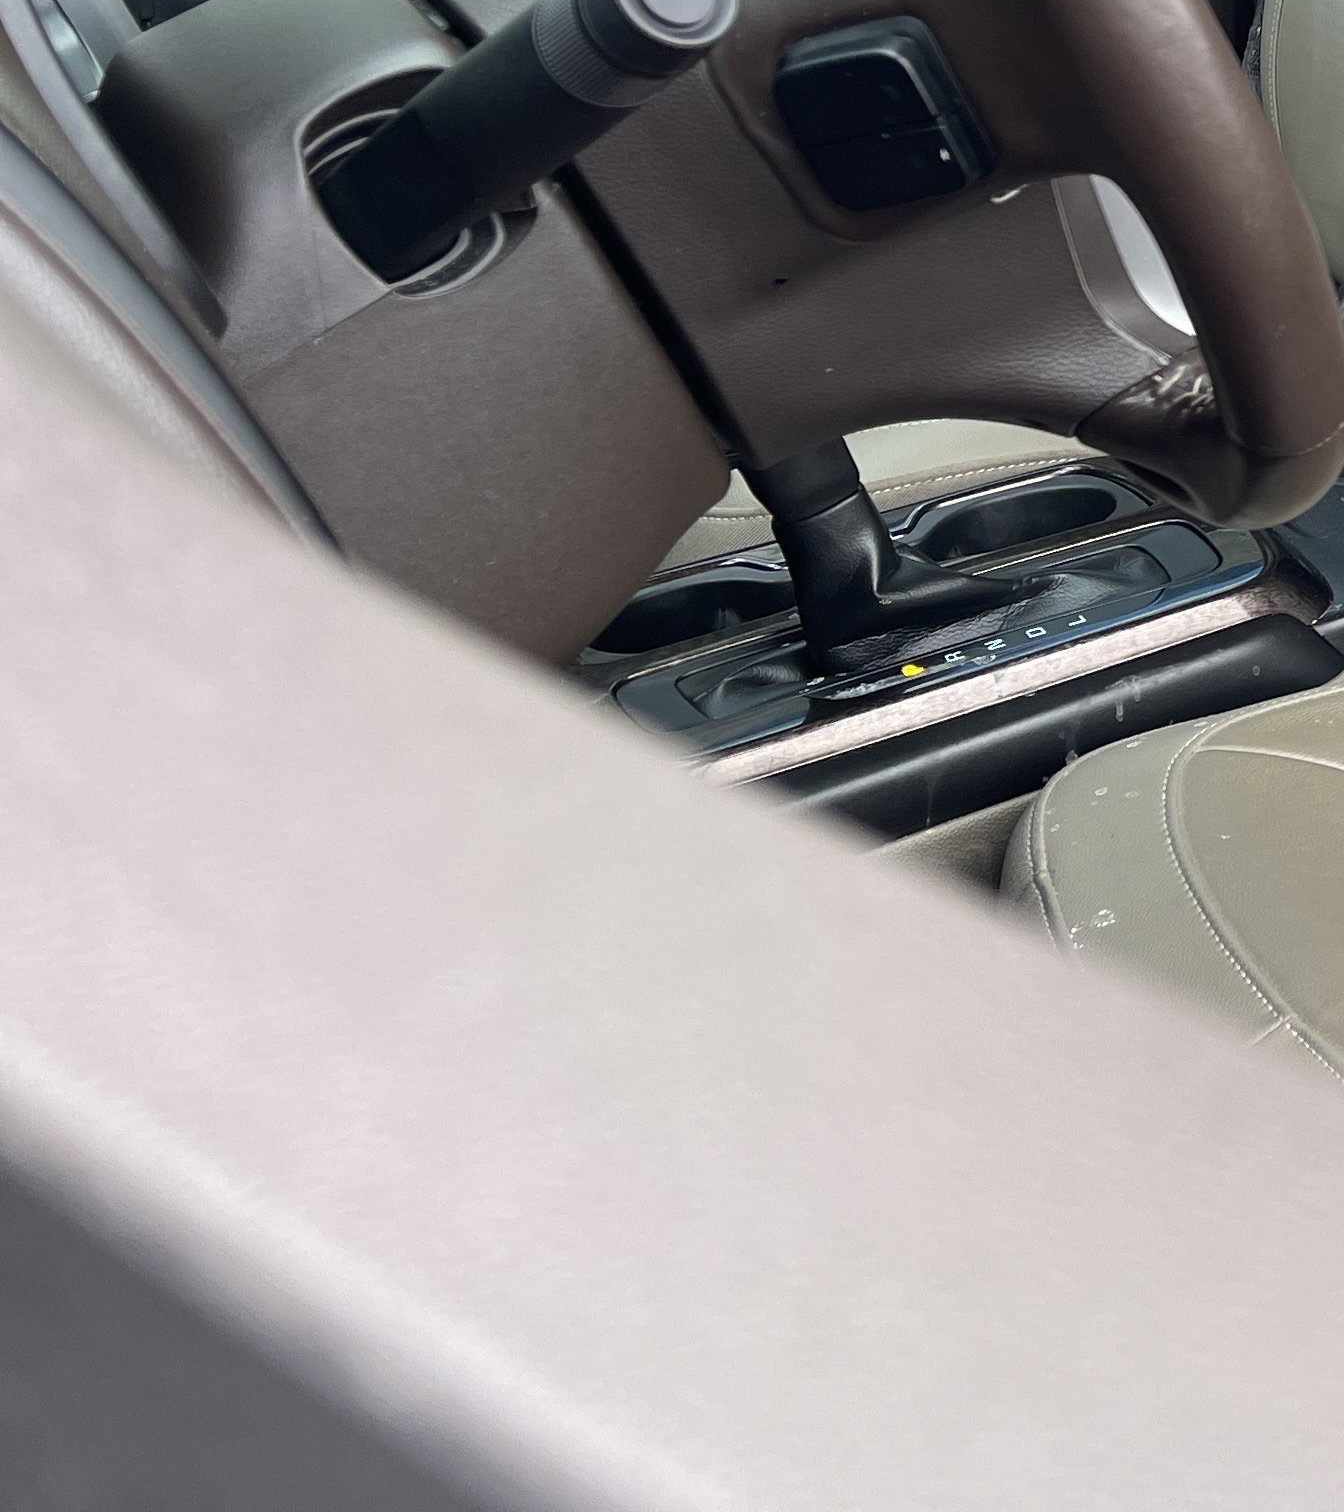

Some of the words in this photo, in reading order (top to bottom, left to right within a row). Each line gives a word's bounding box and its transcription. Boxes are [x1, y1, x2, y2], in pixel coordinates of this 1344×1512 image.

[944, 651, 964, 662] R
[984, 638, 1005, 650] N
[1026, 626, 1046, 638] D
[1069, 615, 1086, 627] L
